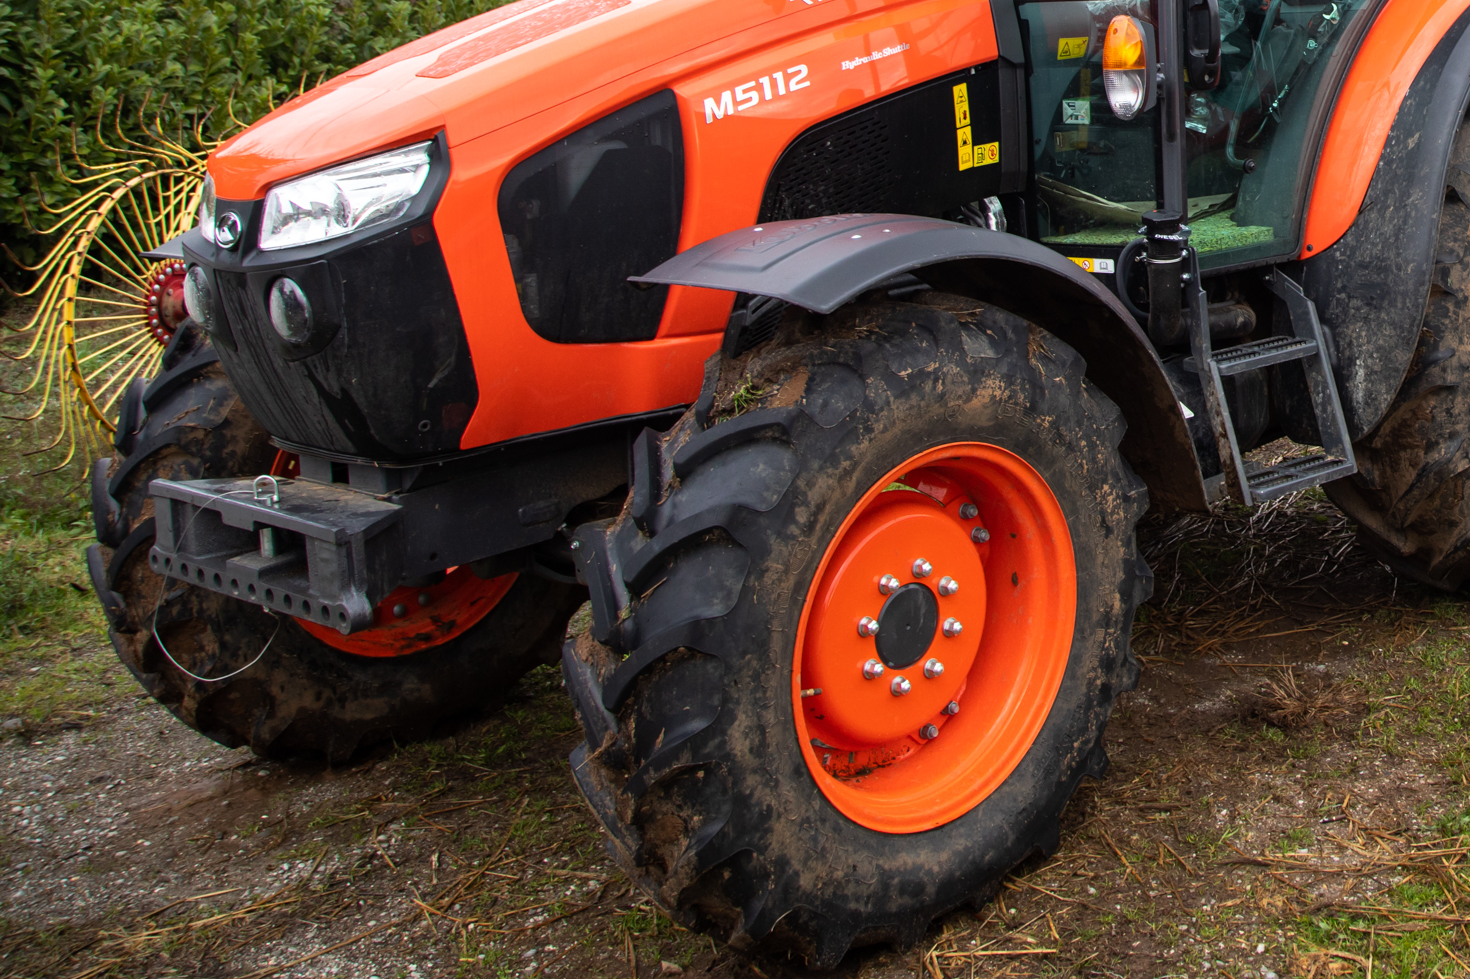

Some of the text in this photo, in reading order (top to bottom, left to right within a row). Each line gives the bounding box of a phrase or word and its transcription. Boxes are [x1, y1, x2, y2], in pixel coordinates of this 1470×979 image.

[841, 42, 910, 70] Hydraulic Shuttle
[703, 64, 811, 124] M5112
